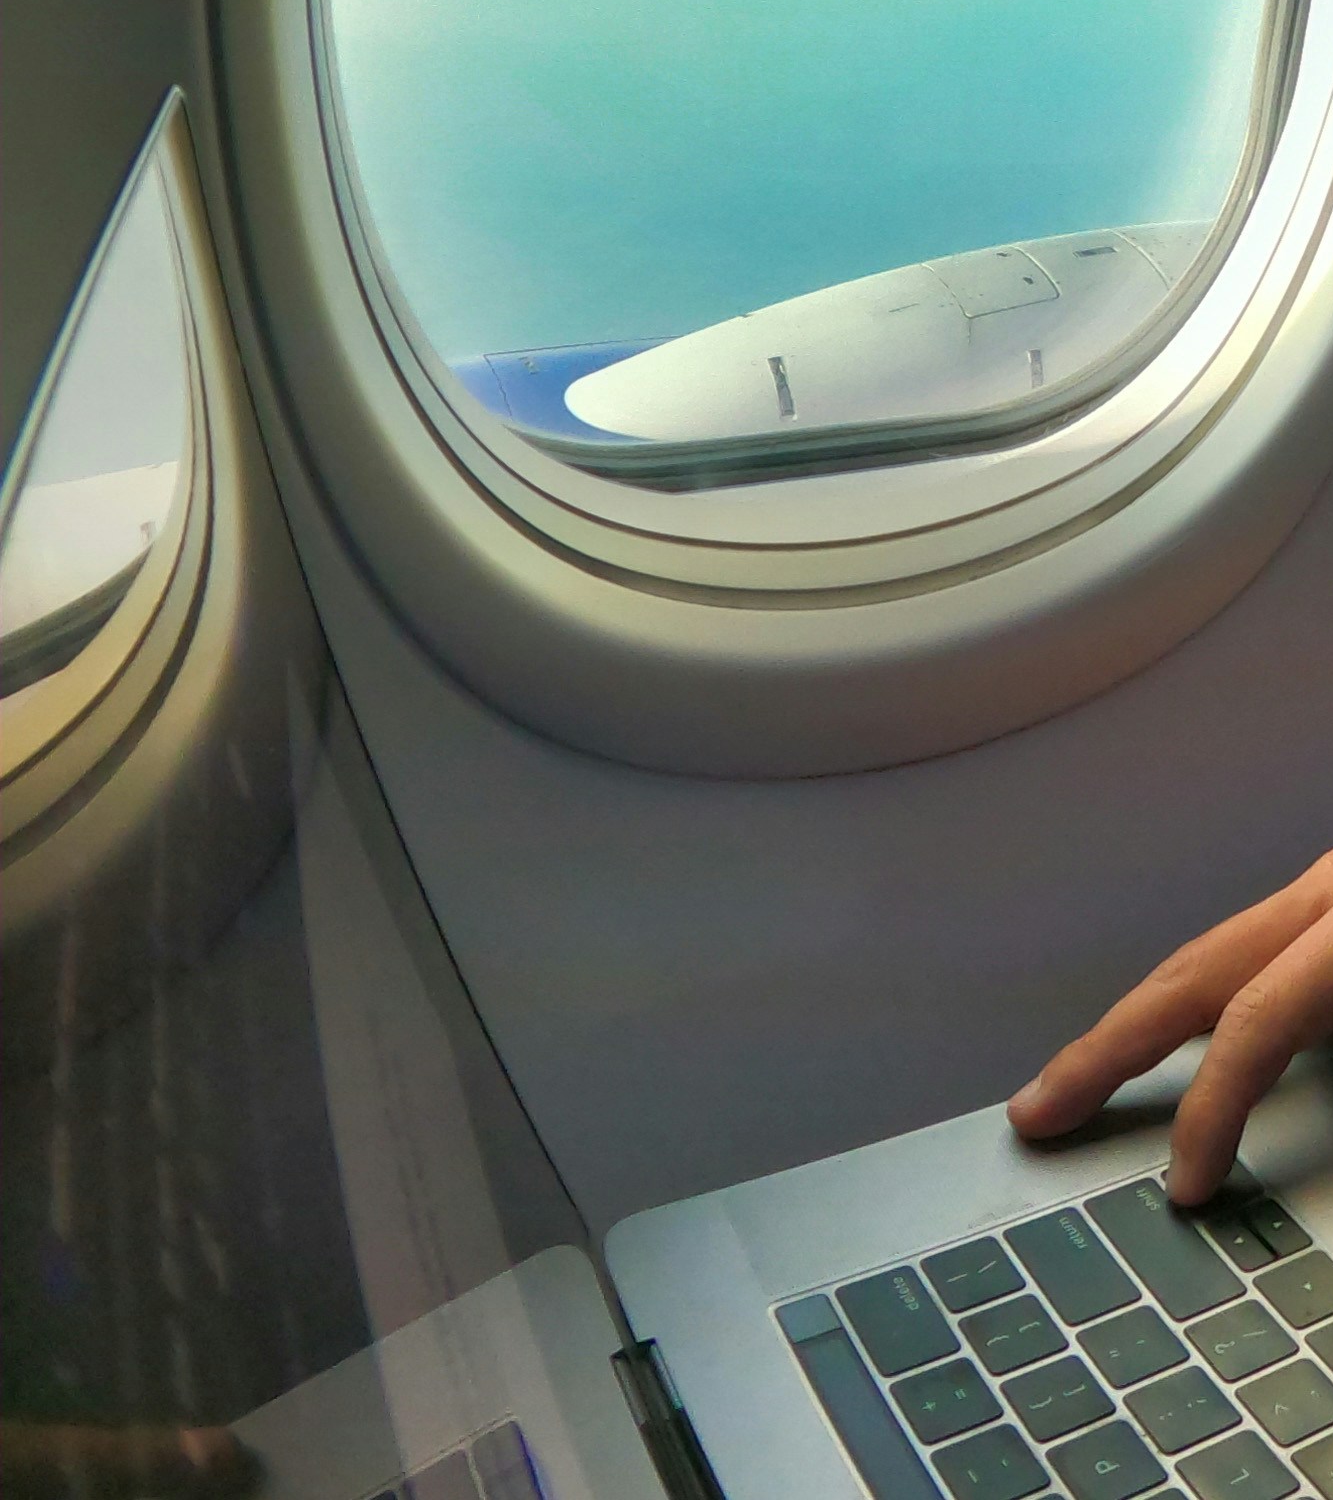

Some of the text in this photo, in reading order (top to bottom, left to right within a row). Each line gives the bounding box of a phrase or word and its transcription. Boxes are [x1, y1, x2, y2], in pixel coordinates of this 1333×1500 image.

[1135, 1187, 1160, 1211] shift
[1059, 1217, 1088, 1250] return
[893, 1276, 920, 1311] delete
[1094, 1460, 1121, 1475] P
[1230, 1468, 1250, 1485] L
